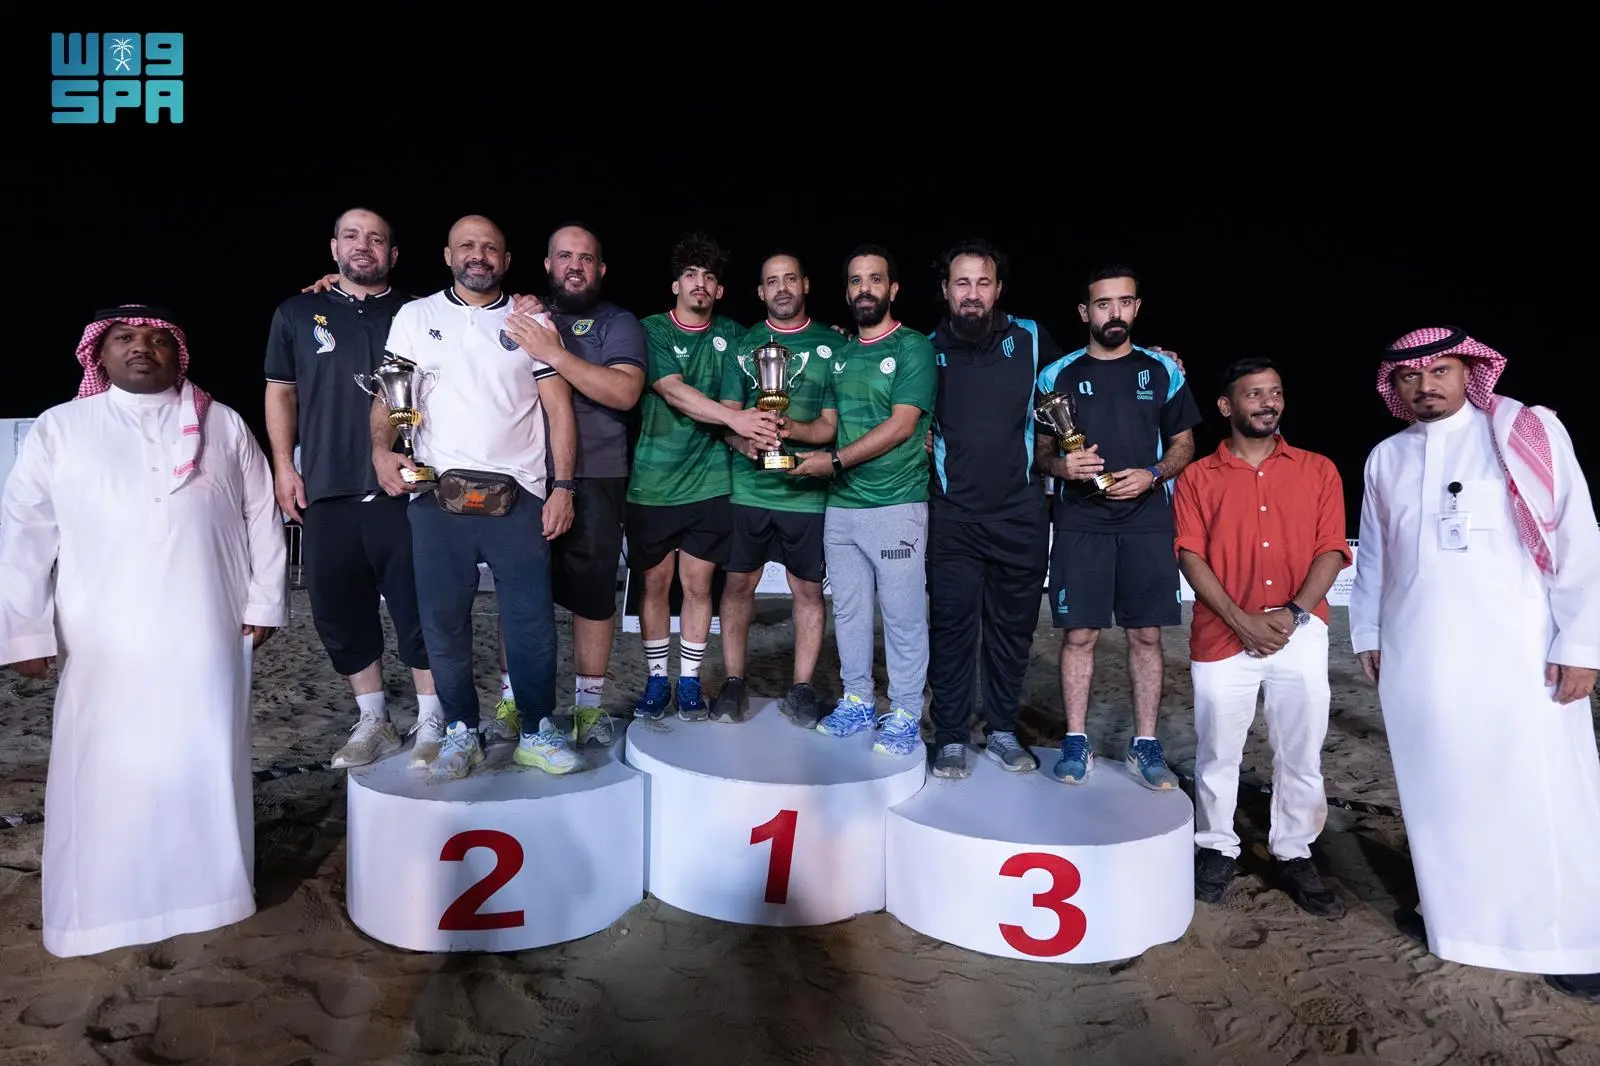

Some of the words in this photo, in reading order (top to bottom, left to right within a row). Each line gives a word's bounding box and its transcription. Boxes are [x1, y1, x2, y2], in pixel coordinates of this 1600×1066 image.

[1079, 381, 1094, 396] Q
[881, 549, 911, 559] PUMA
[439, 830, 525, 930] 2
[751, 810, 799, 905] 1
[999, 853, 1087, 957] 3
